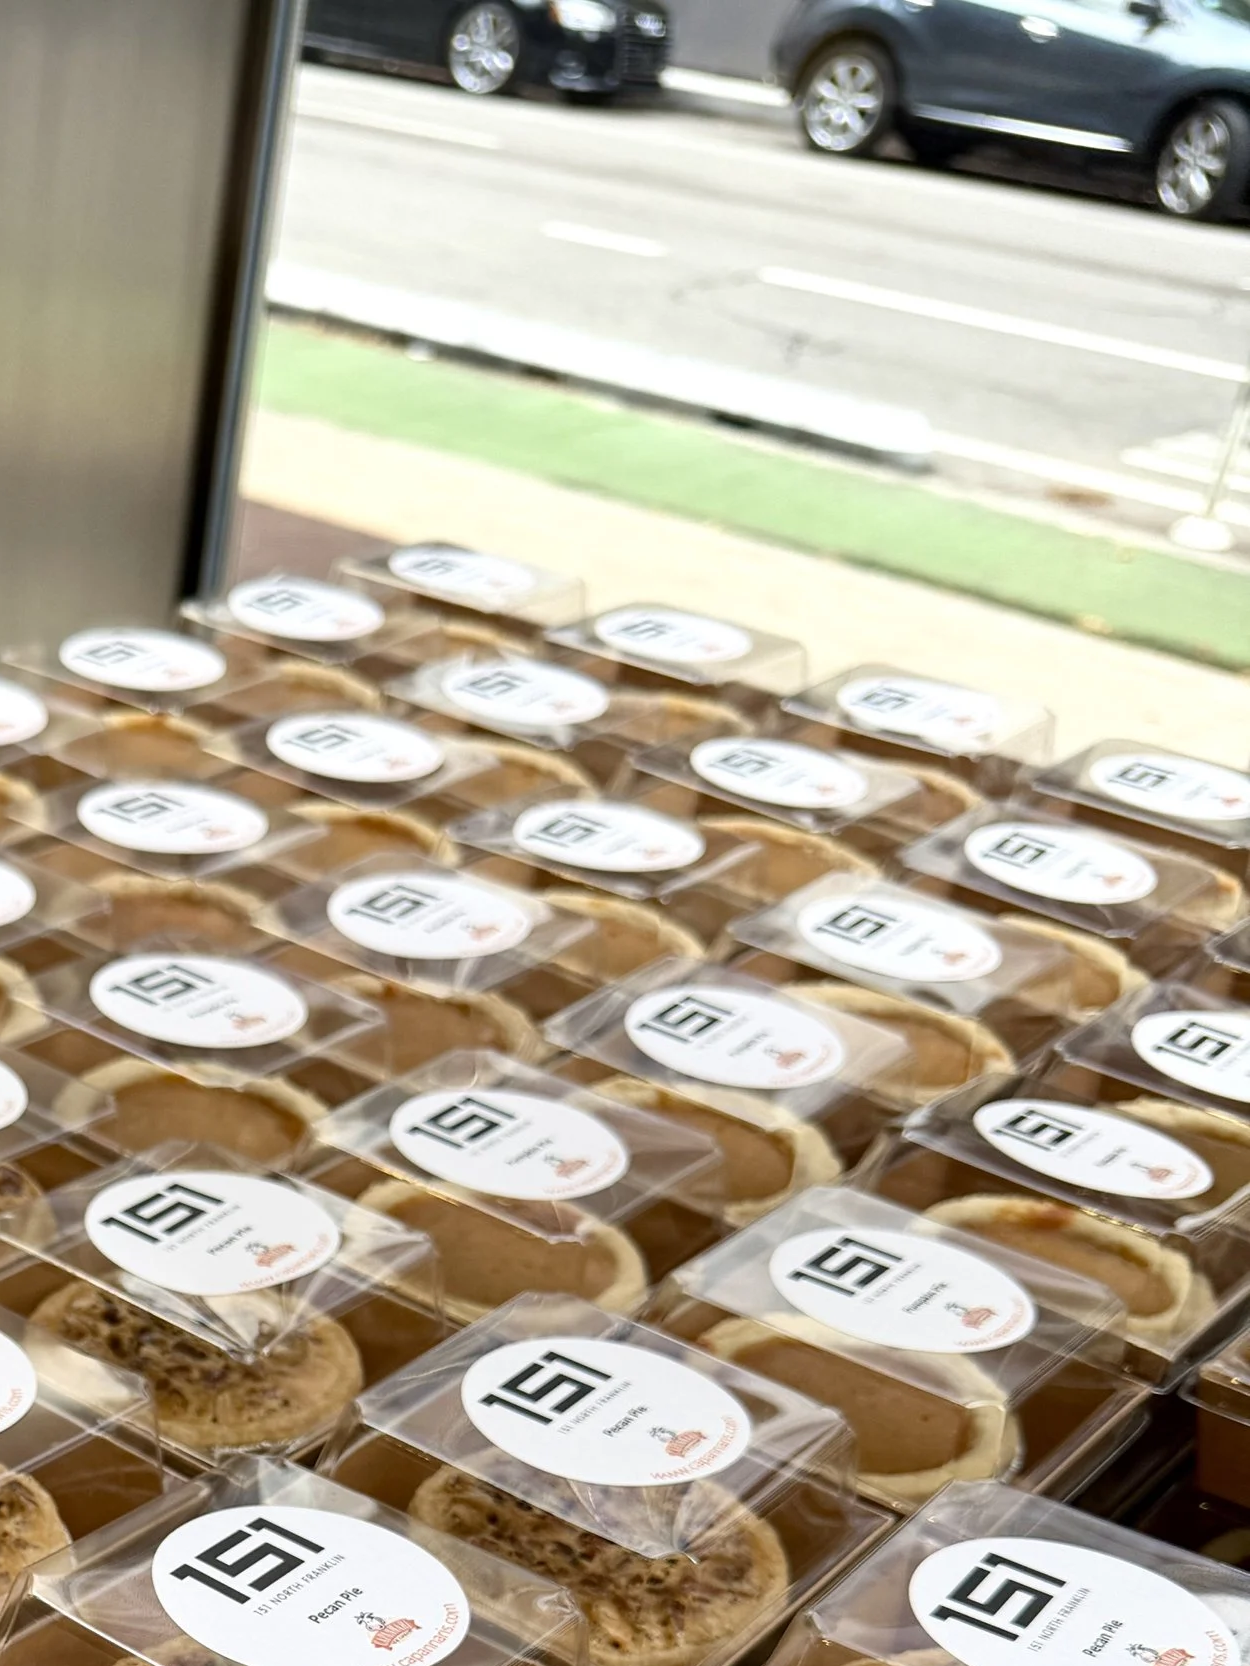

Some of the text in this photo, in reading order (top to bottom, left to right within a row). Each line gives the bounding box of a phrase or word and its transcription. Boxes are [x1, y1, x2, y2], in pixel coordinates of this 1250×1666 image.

[482, 1352, 611, 1424] 151
[171, 1518, 324, 1604] 151
[254, 1555, 346, 1615] 151 NORTH FRANKLIN
[307, 1588, 363, 1623] Pecan Pie
[933, 1554, 1065, 1641] 151
[1082, 1621, 1123, 1657] Pecan Pie
